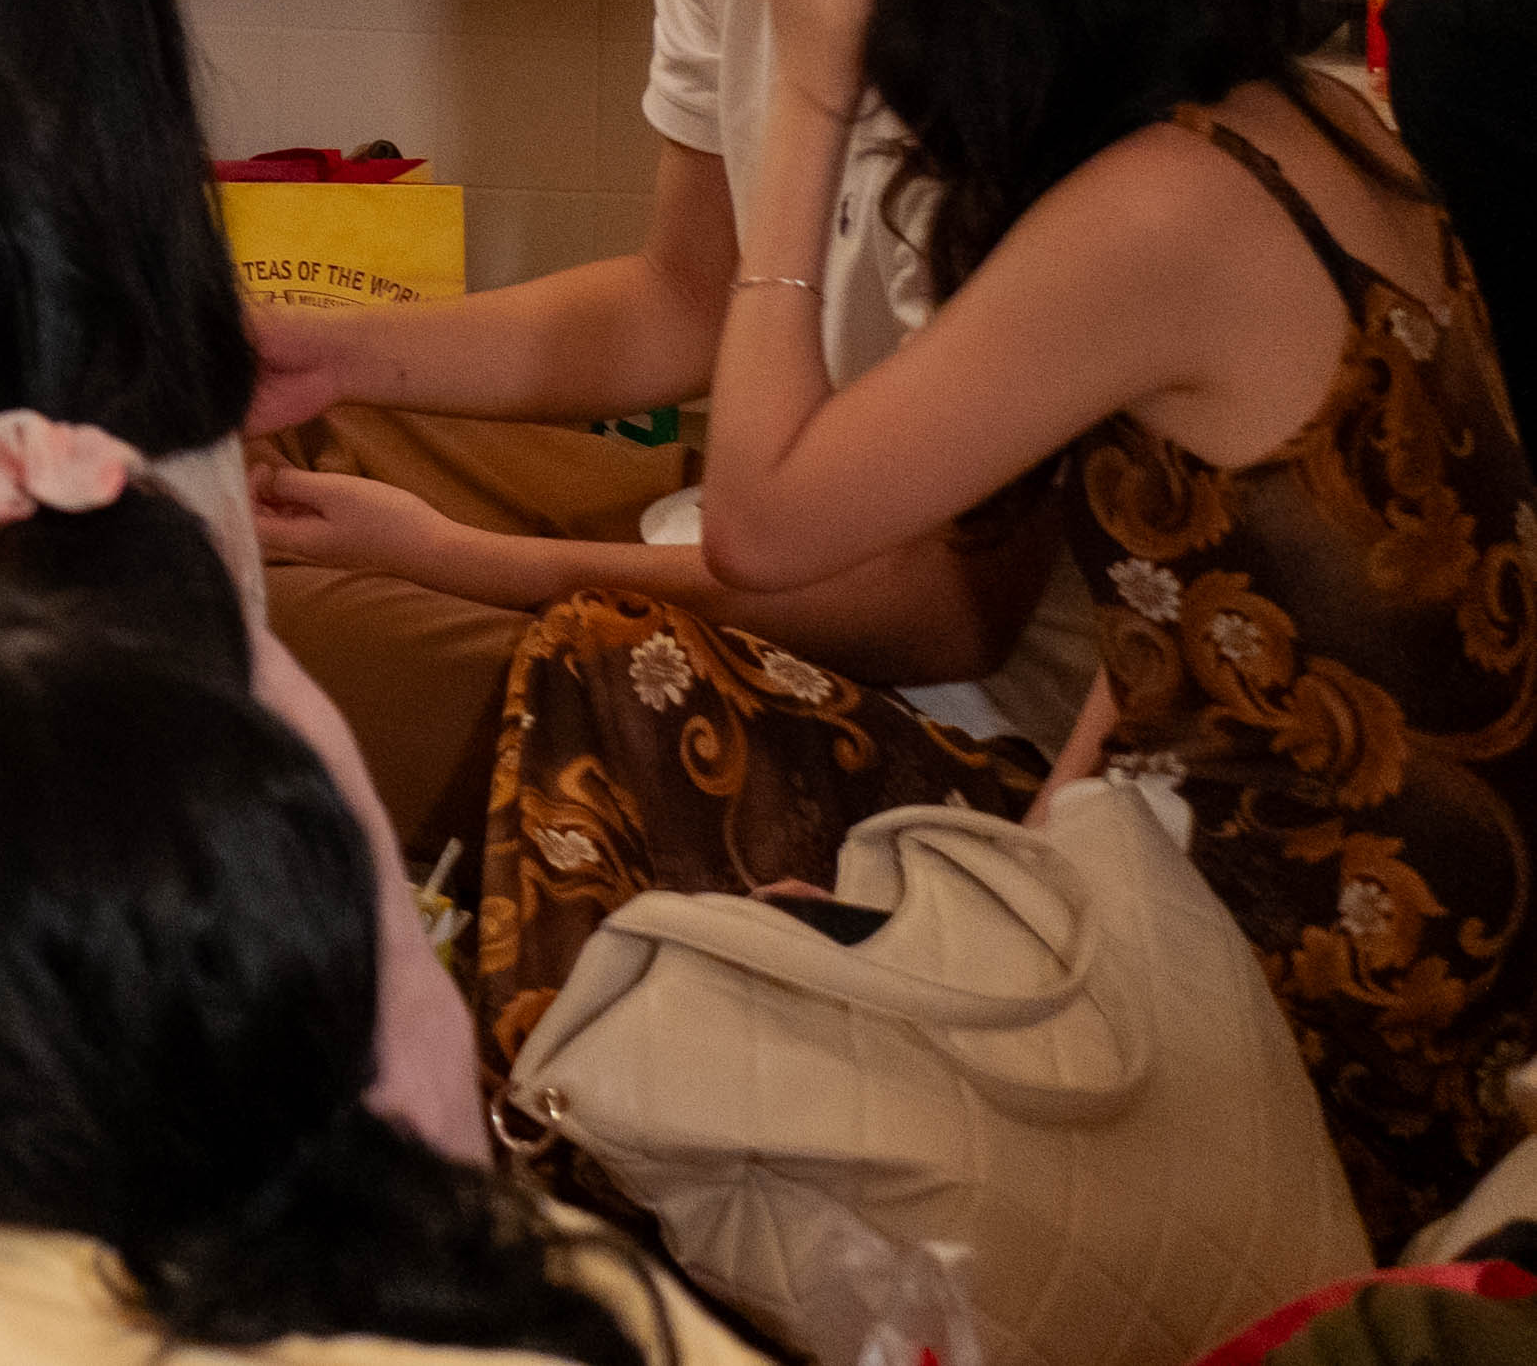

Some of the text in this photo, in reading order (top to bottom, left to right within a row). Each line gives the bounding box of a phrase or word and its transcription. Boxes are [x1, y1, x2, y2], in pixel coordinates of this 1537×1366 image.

[241, 260, 292, 281] TEAS
[297, 261, 322, 282] OF
[326, 264, 366, 291] THE
